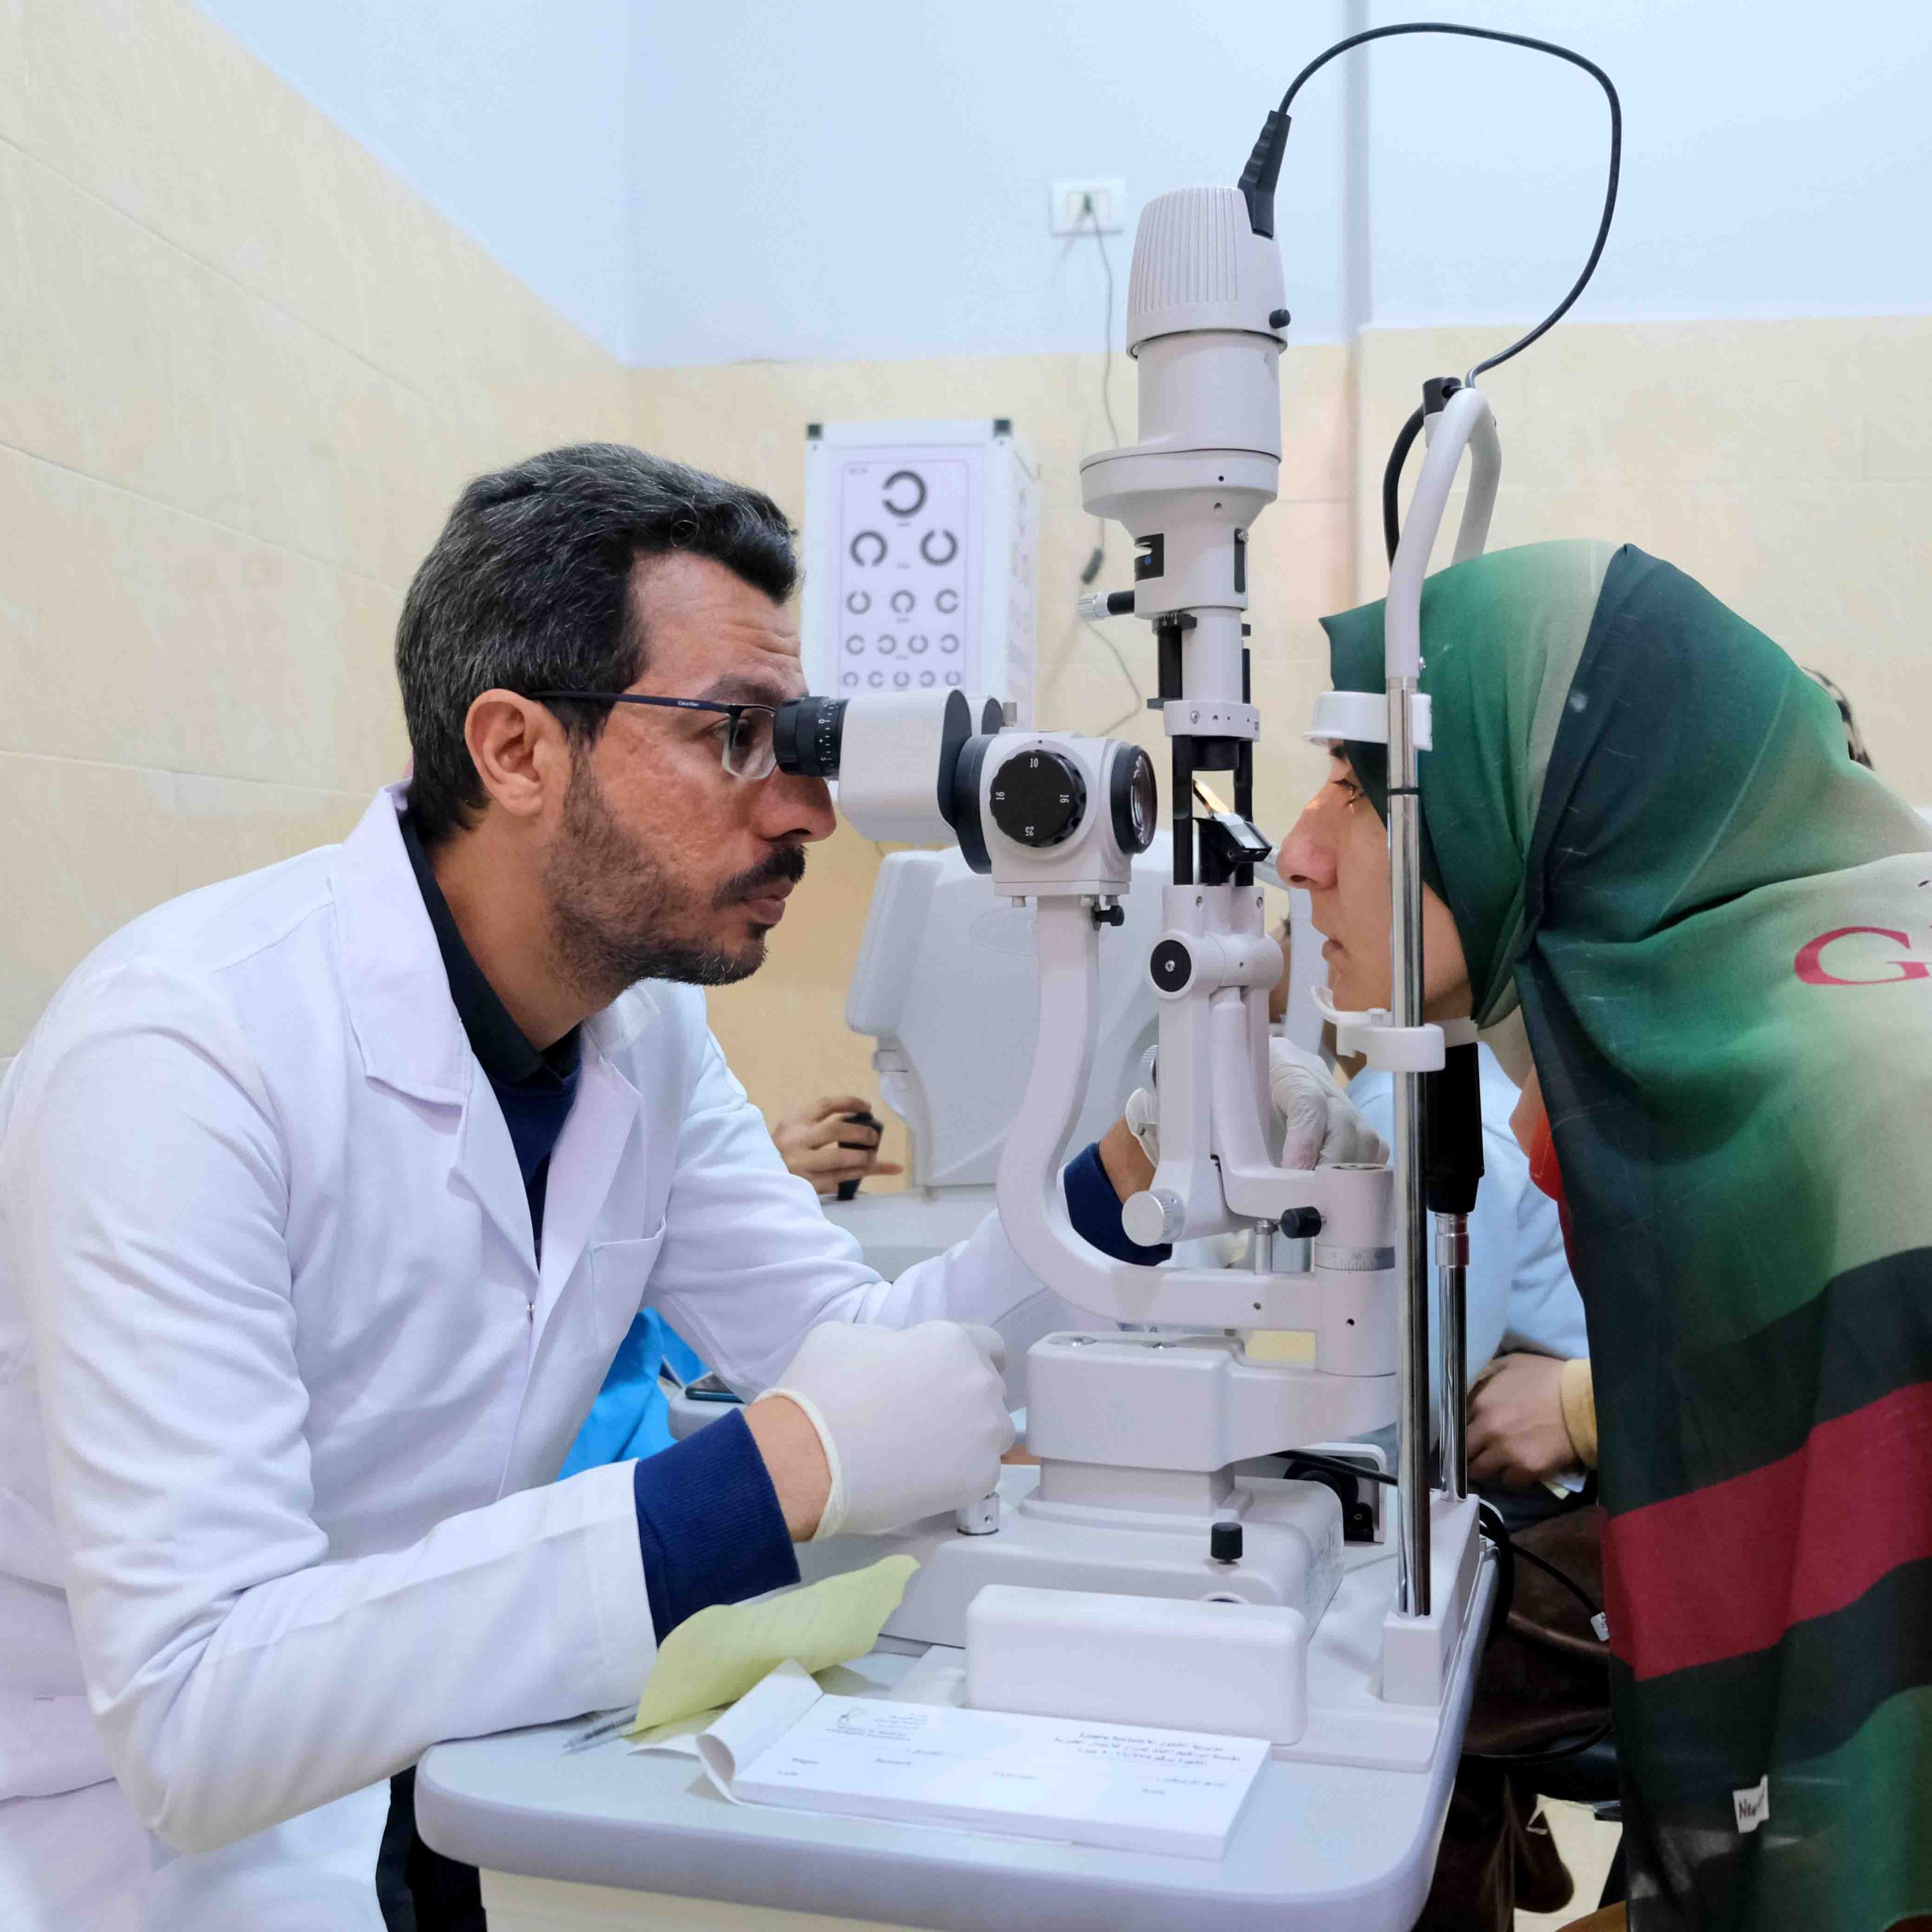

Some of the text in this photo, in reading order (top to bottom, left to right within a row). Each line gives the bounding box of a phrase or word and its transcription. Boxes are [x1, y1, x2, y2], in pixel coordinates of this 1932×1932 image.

[1029, 758, 1038, 768] 10
[995, 791, 1005, 801] 16
[1060, 794, 1069, 804] 16
[1025, 826, 1035, 836] 25
